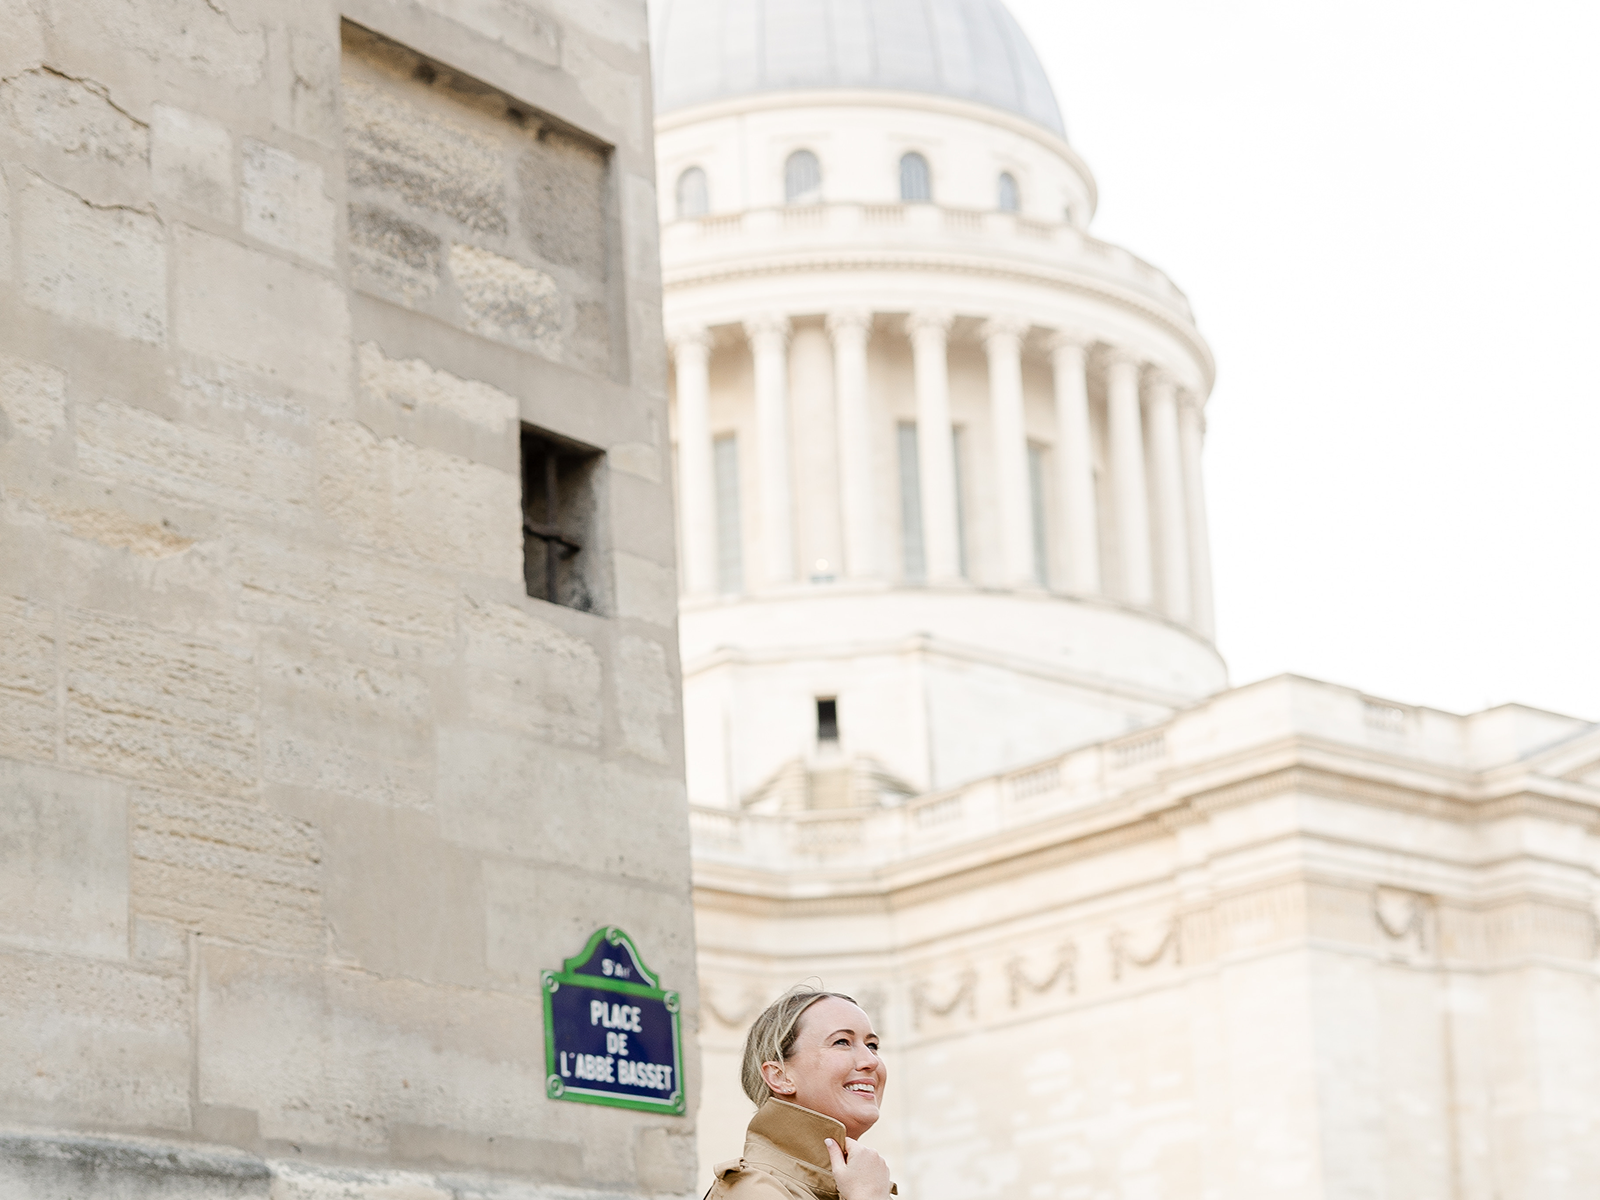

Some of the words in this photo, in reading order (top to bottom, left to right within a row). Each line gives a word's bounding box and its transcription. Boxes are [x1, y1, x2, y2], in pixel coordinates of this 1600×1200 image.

[590, 999, 642, 1033] PLACE
[606, 1031, 629, 1056] DE
[617, 1059, 673, 1091] BASSET
